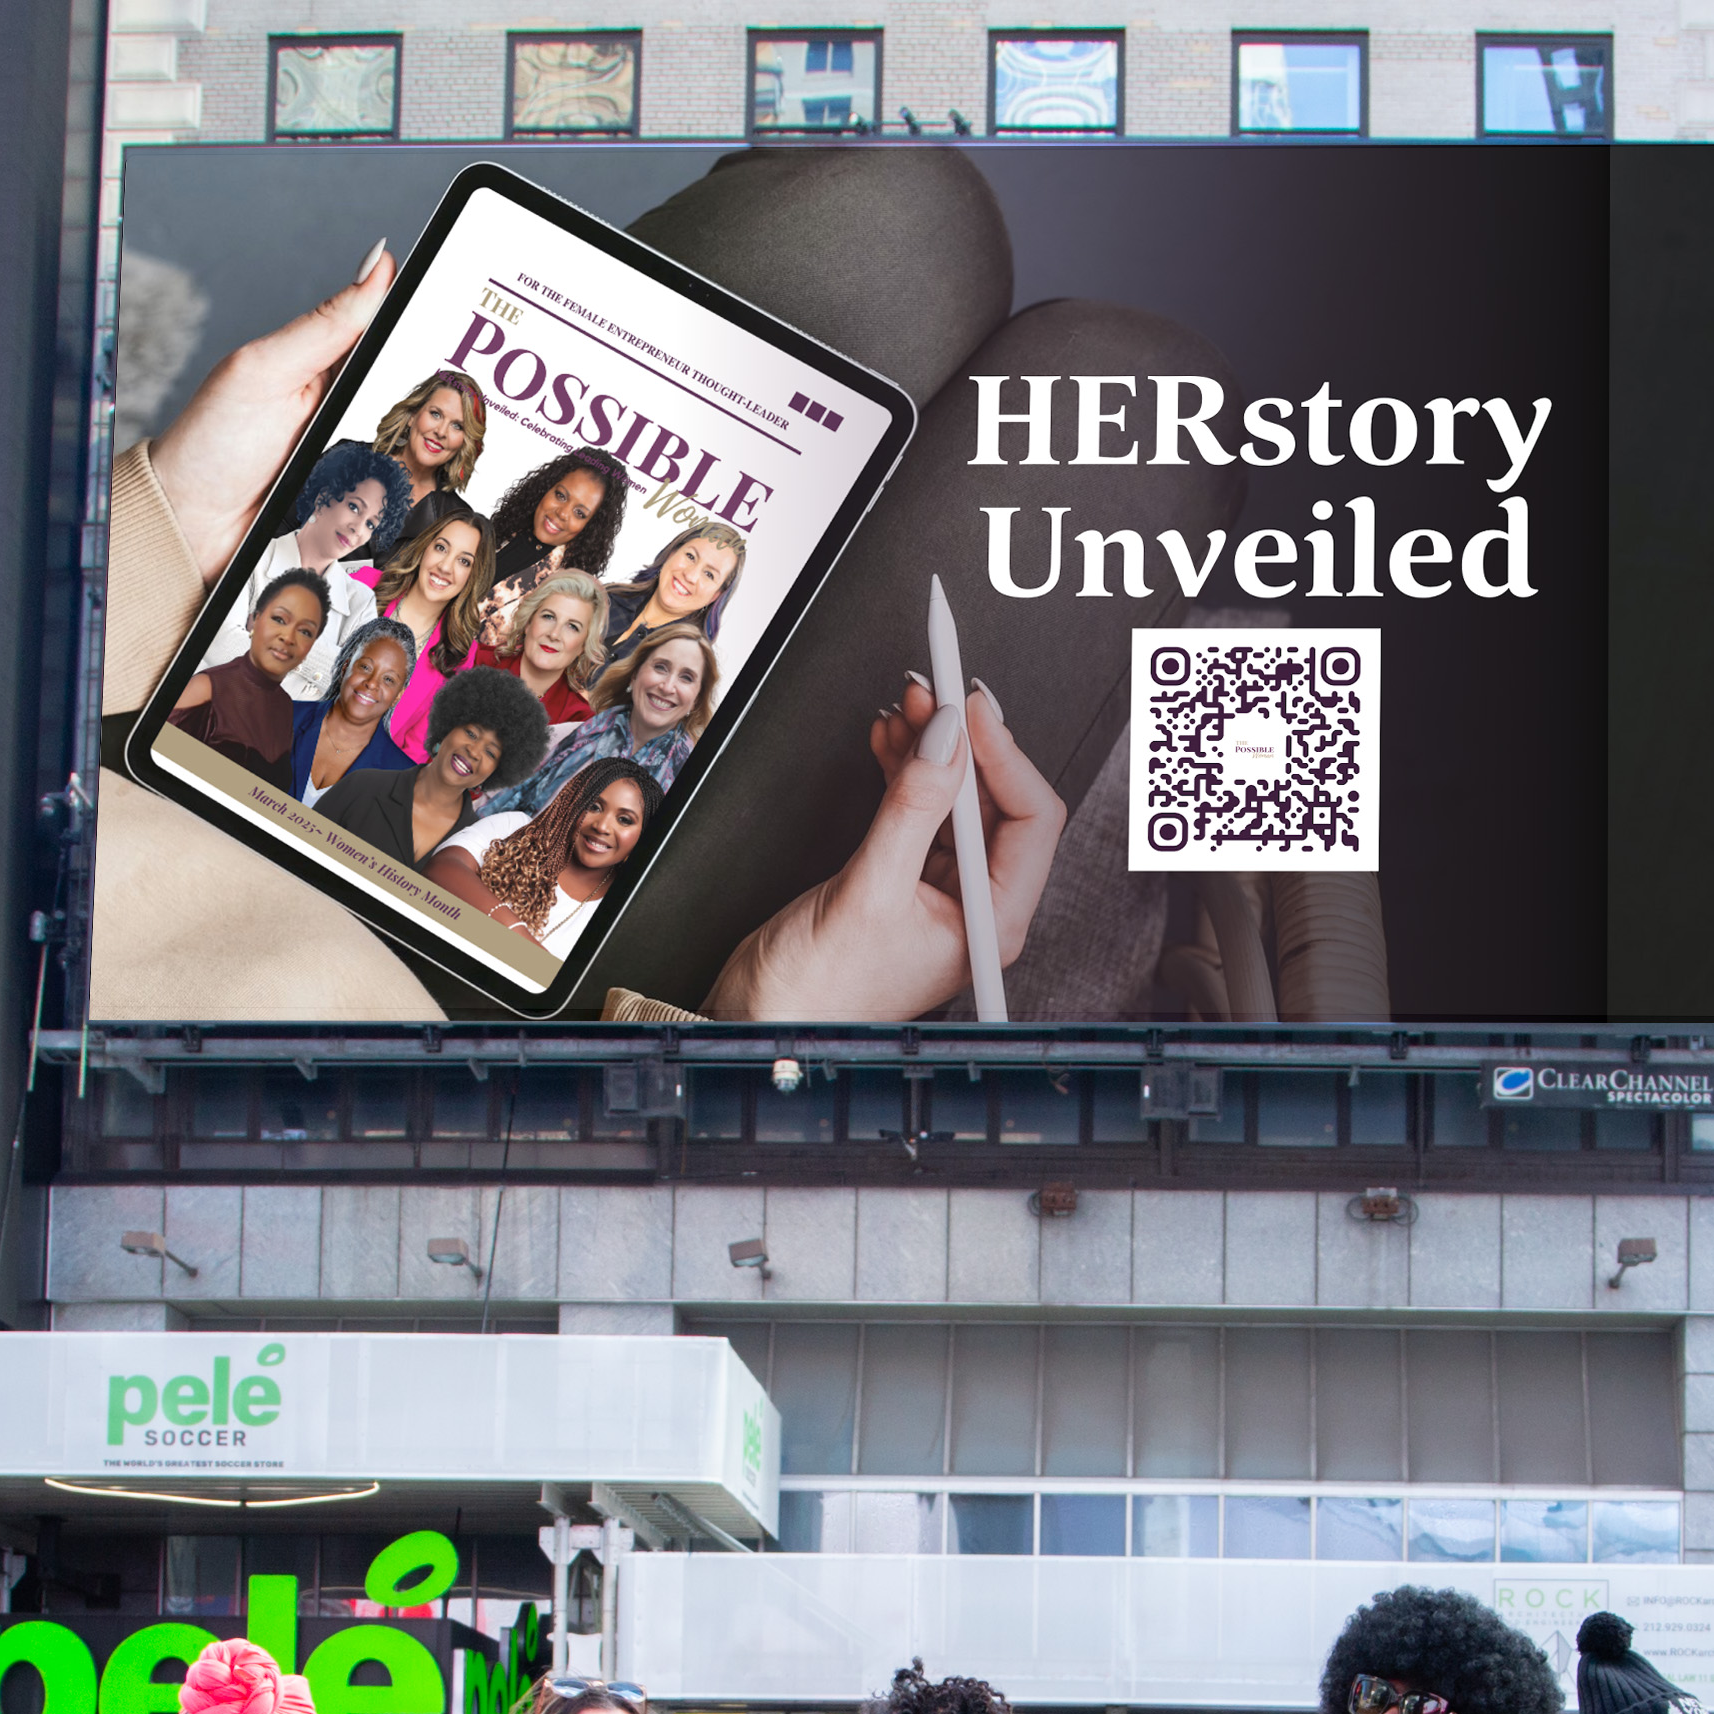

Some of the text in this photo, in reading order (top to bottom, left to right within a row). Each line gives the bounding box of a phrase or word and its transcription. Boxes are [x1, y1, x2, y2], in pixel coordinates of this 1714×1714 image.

[481, 286, 524, 325] THE
[517, 272, 790, 430] FOR THE FEMALE ENTREPRENEUR THOUGHT-LEADER
[444, 311, 774, 533] POSSIBLE
[520, 417, 574, 453] Celebrating
[574, 447, 611, 475] Leading
[612, 468, 647, 494] Women
[967, 374, 1553, 493] HERstory
[643, 477, 747, 555] Woman
[979, 496, 1539, 599] Unveiled
[248, 786, 287, 815] March
[326, 832, 378, 870] Women's
[377, 863, 422, 897] History
[421, 890, 462, 920] Month
[1607, 1091, 1712, 1104] SPECTACOLOR
[107, 1342, 286, 1445] pelé
[104, 1459, 284, 1469] THE WORLD'S GREATEST SOCCER STORE
[145, 1430, 247, 1446] SOCCER
[1498, 1588, 1601, 1609] ROCK
[1643, 1623, 1711, 1632] 212.929.0324
